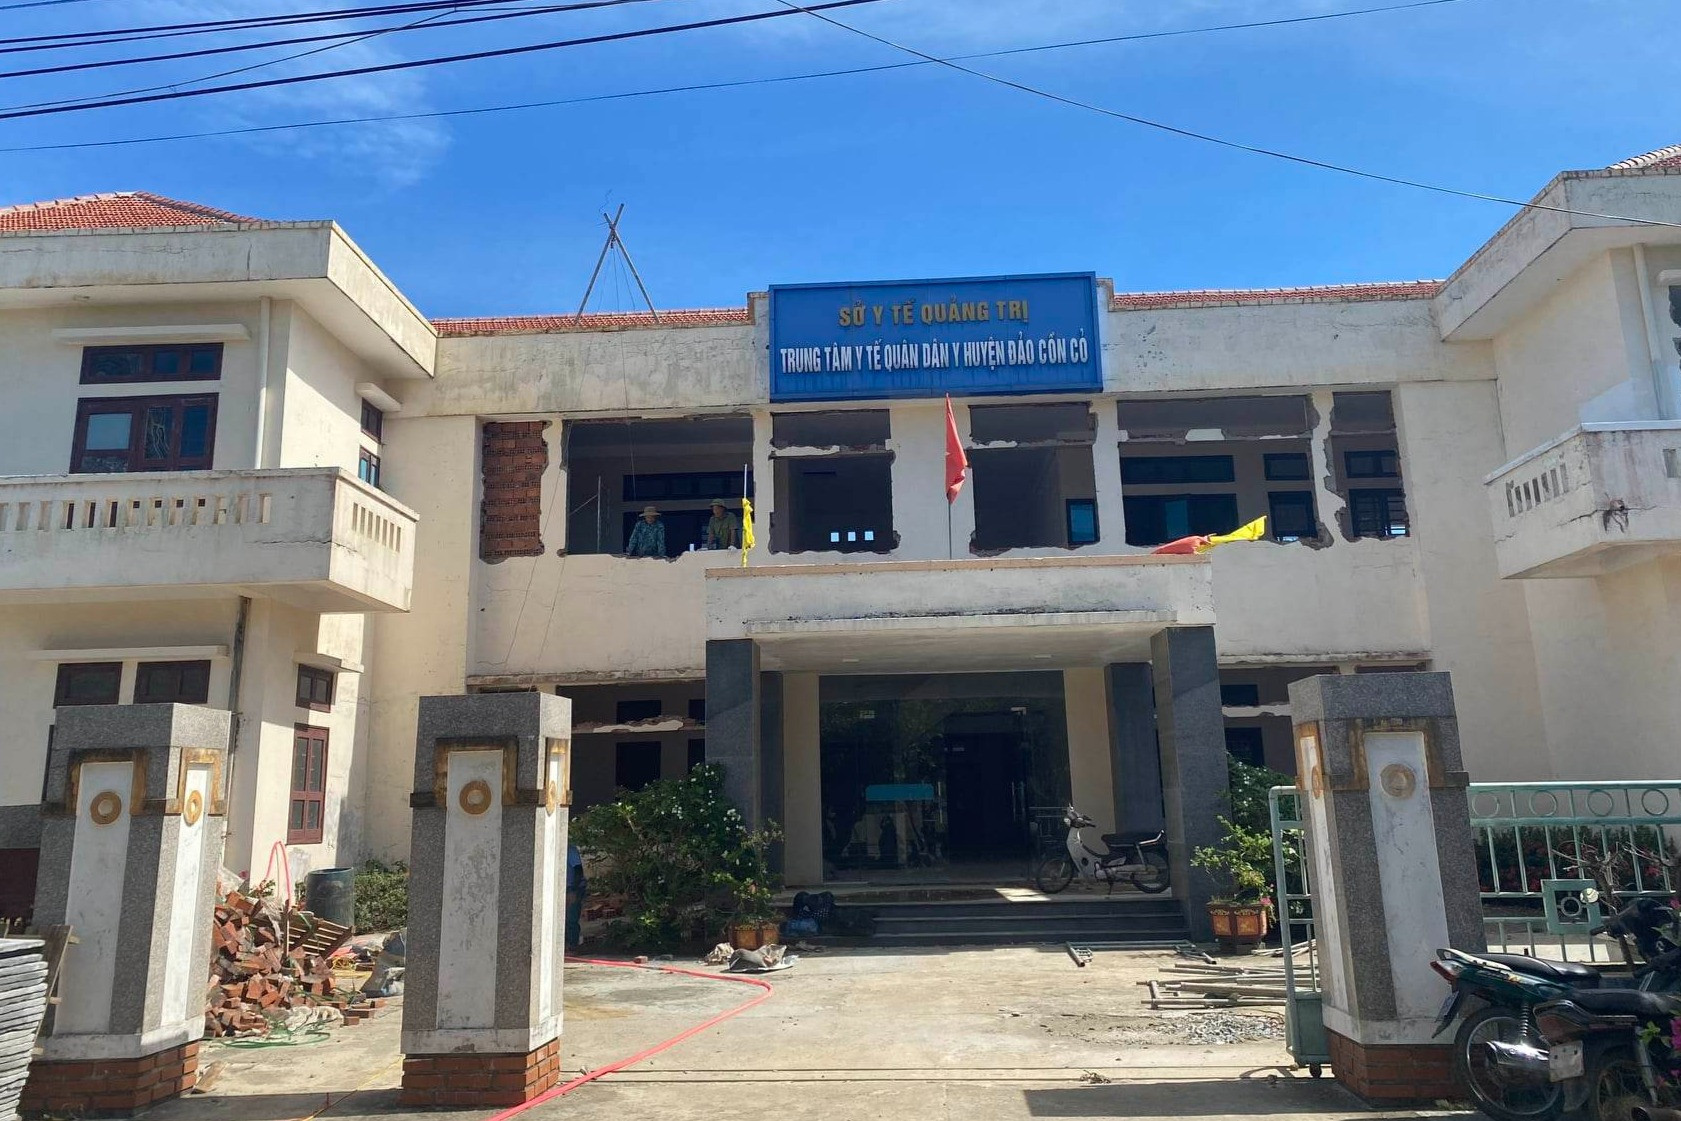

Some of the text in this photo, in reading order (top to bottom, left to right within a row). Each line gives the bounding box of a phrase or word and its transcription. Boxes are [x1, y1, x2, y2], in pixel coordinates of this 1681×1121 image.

[839, 294, 1029, 327] SỞ Y TẾ QUẢNG TRỊ
[780, 347, 822, 373] TRUNG
[824, 342, 852, 371] TÂM
[855, 346, 863, 370] Y
[866, 338, 882, 370] TẾ
[884, 339, 919, 372] QUÂN
[923, 338, 949, 368] DÂN
[952, 342, 960, 367] Y
[963, 336, 1005, 371] HUYỆN
[1008, 331, 1035, 366] ĐẢO
[1070, 328, 1088, 363] CỎ
